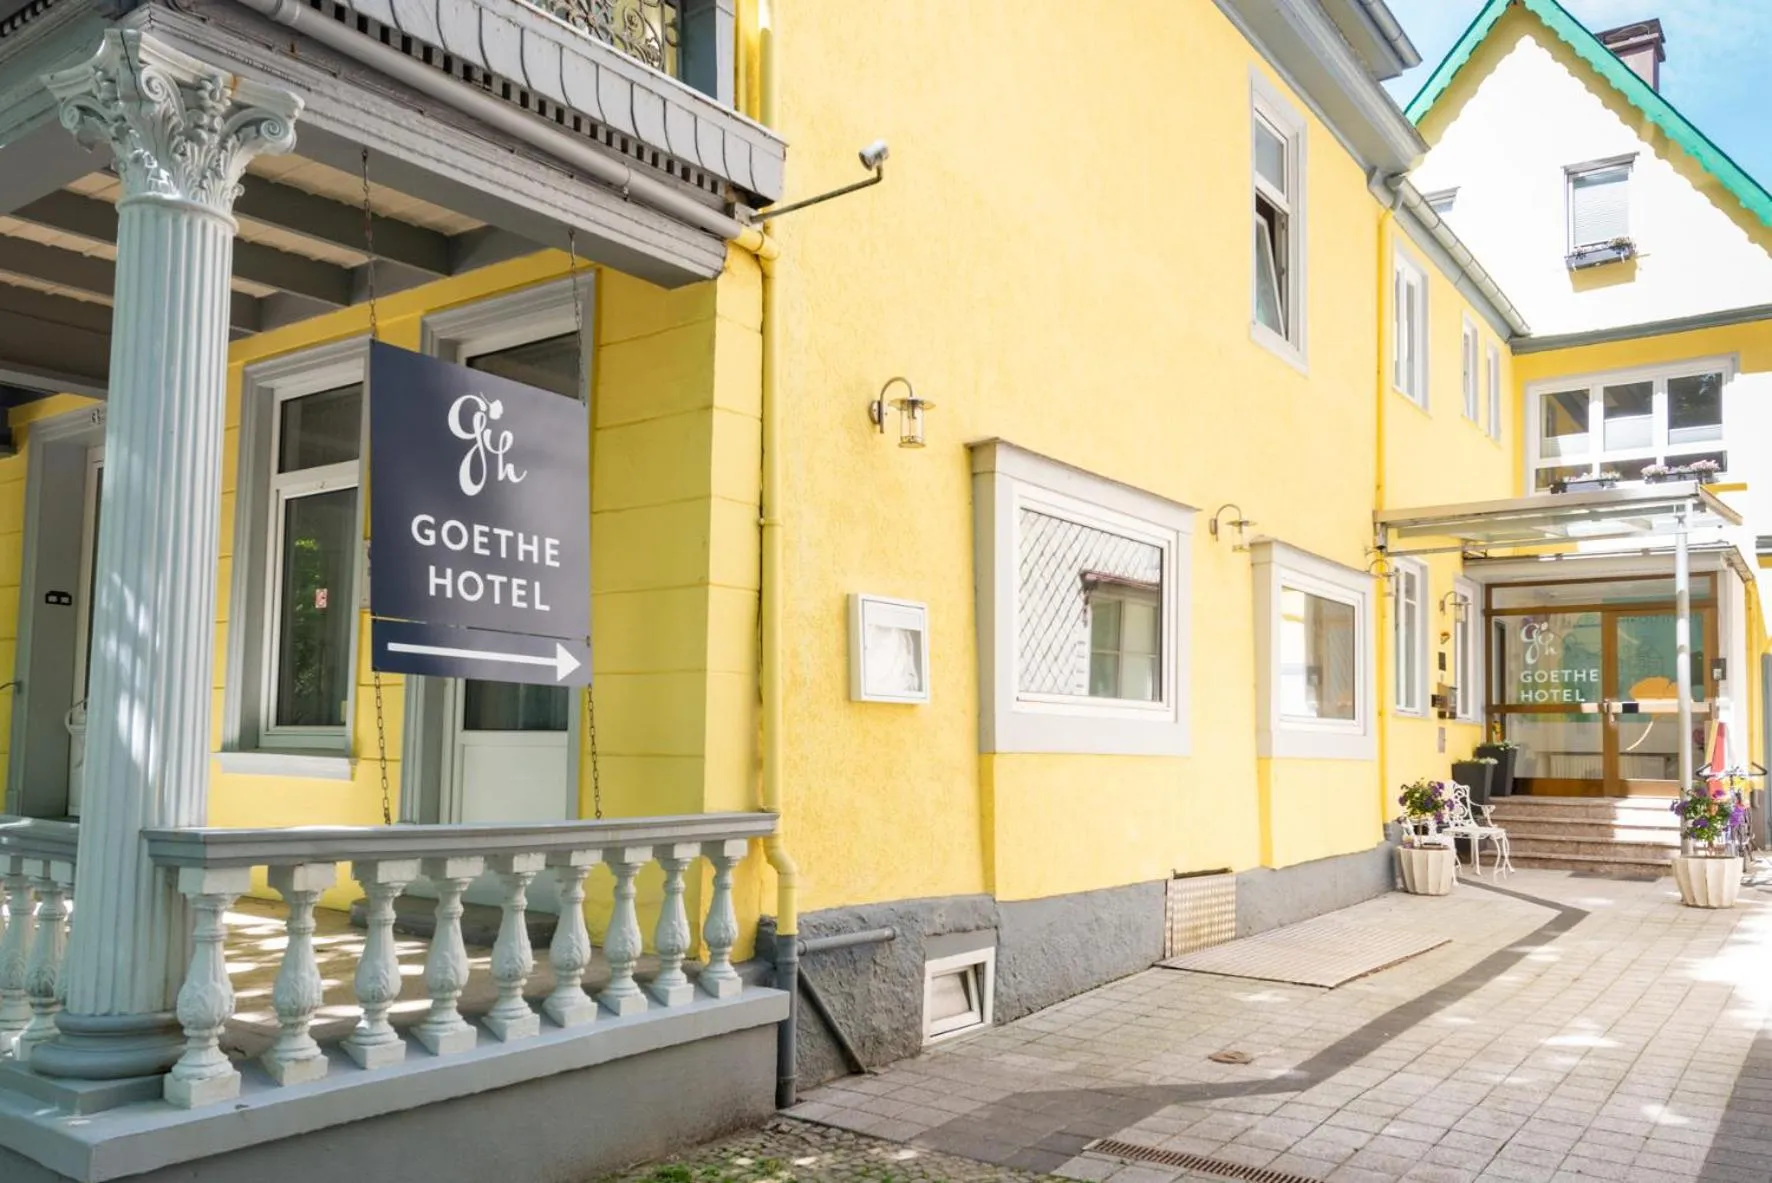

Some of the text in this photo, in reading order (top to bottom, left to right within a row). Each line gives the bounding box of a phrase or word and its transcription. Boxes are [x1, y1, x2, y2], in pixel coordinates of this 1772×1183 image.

[411, 514, 560, 567] GOETHE
[428, 565, 550, 611] HOTEL
[1520, 669, 1600, 683] GOETHE
[1520, 688, 1585, 702] HOTEL
